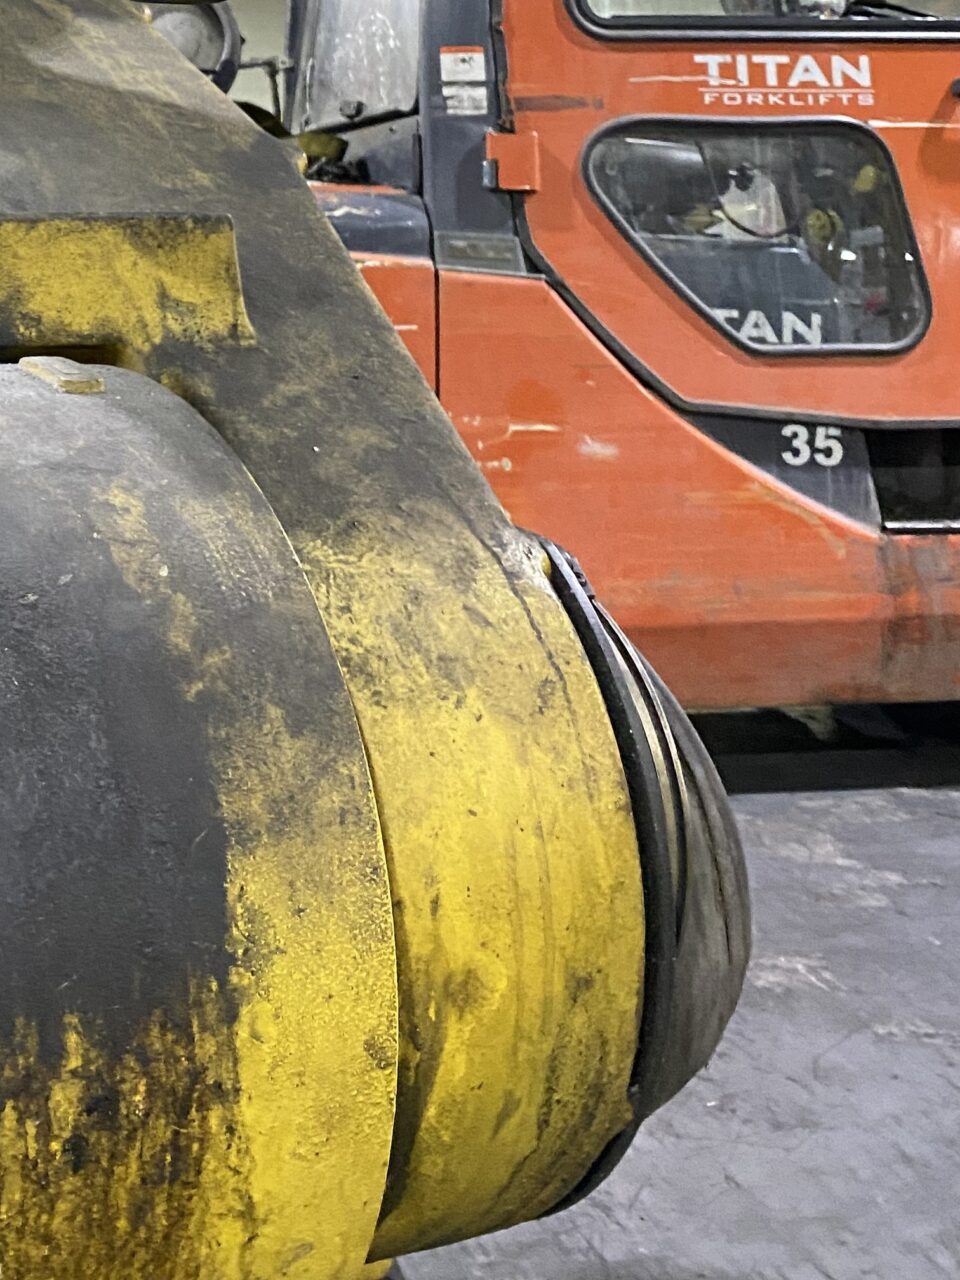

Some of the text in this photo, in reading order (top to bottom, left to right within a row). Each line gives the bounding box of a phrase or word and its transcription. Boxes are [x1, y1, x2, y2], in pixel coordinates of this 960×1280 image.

[693, 54, 872, 87] TITAN
[703, 92, 875, 106] FORKLIFTS
[781, 424, 844, 467] 35
